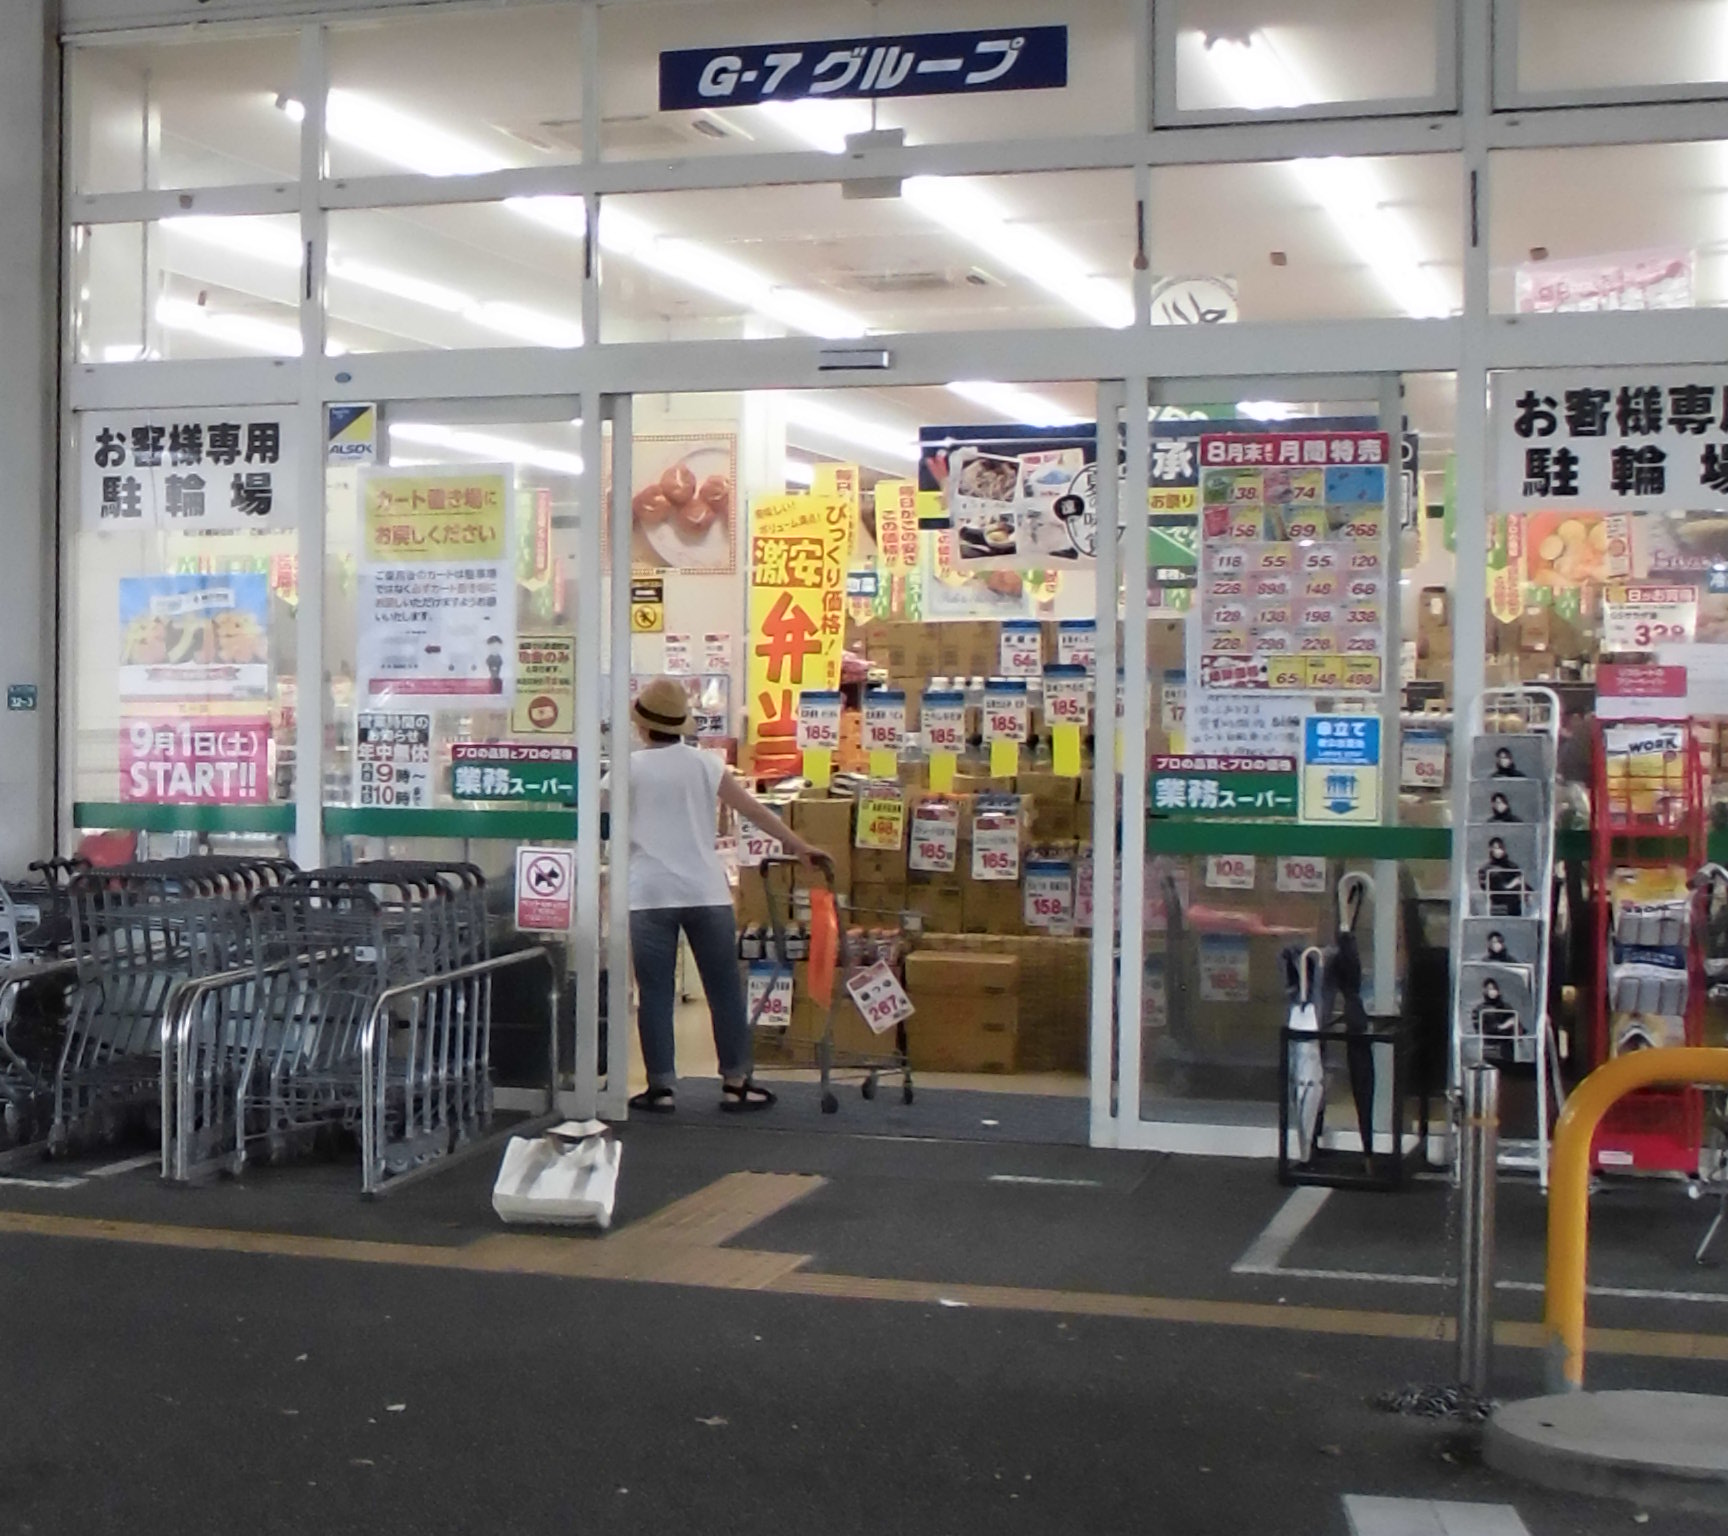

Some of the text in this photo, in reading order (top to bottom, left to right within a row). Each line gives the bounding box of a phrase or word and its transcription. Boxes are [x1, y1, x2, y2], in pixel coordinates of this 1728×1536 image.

[1514, 384, 1728, 438] お客様専
[94, 422, 280, 468] お客様専用
[329, 443, 373, 454] ALSOK
[1279, 439, 1382, 463] 月間特売
[100, 472, 273, 517] 駐輪場
[755, 538, 823, 586] 激安
[130, 721, 259, 757] 9月1日(土)
[456, 748, 573, 761] プロの品質とプロの価格
[129, 761, 257, 798] START!!
[455, 767, 573, 795] 業務スーパー
[1156, 758, 1292, 771] プロの品質とプロの価格
[1155, 777, 1292, 809] 業務スーパー
